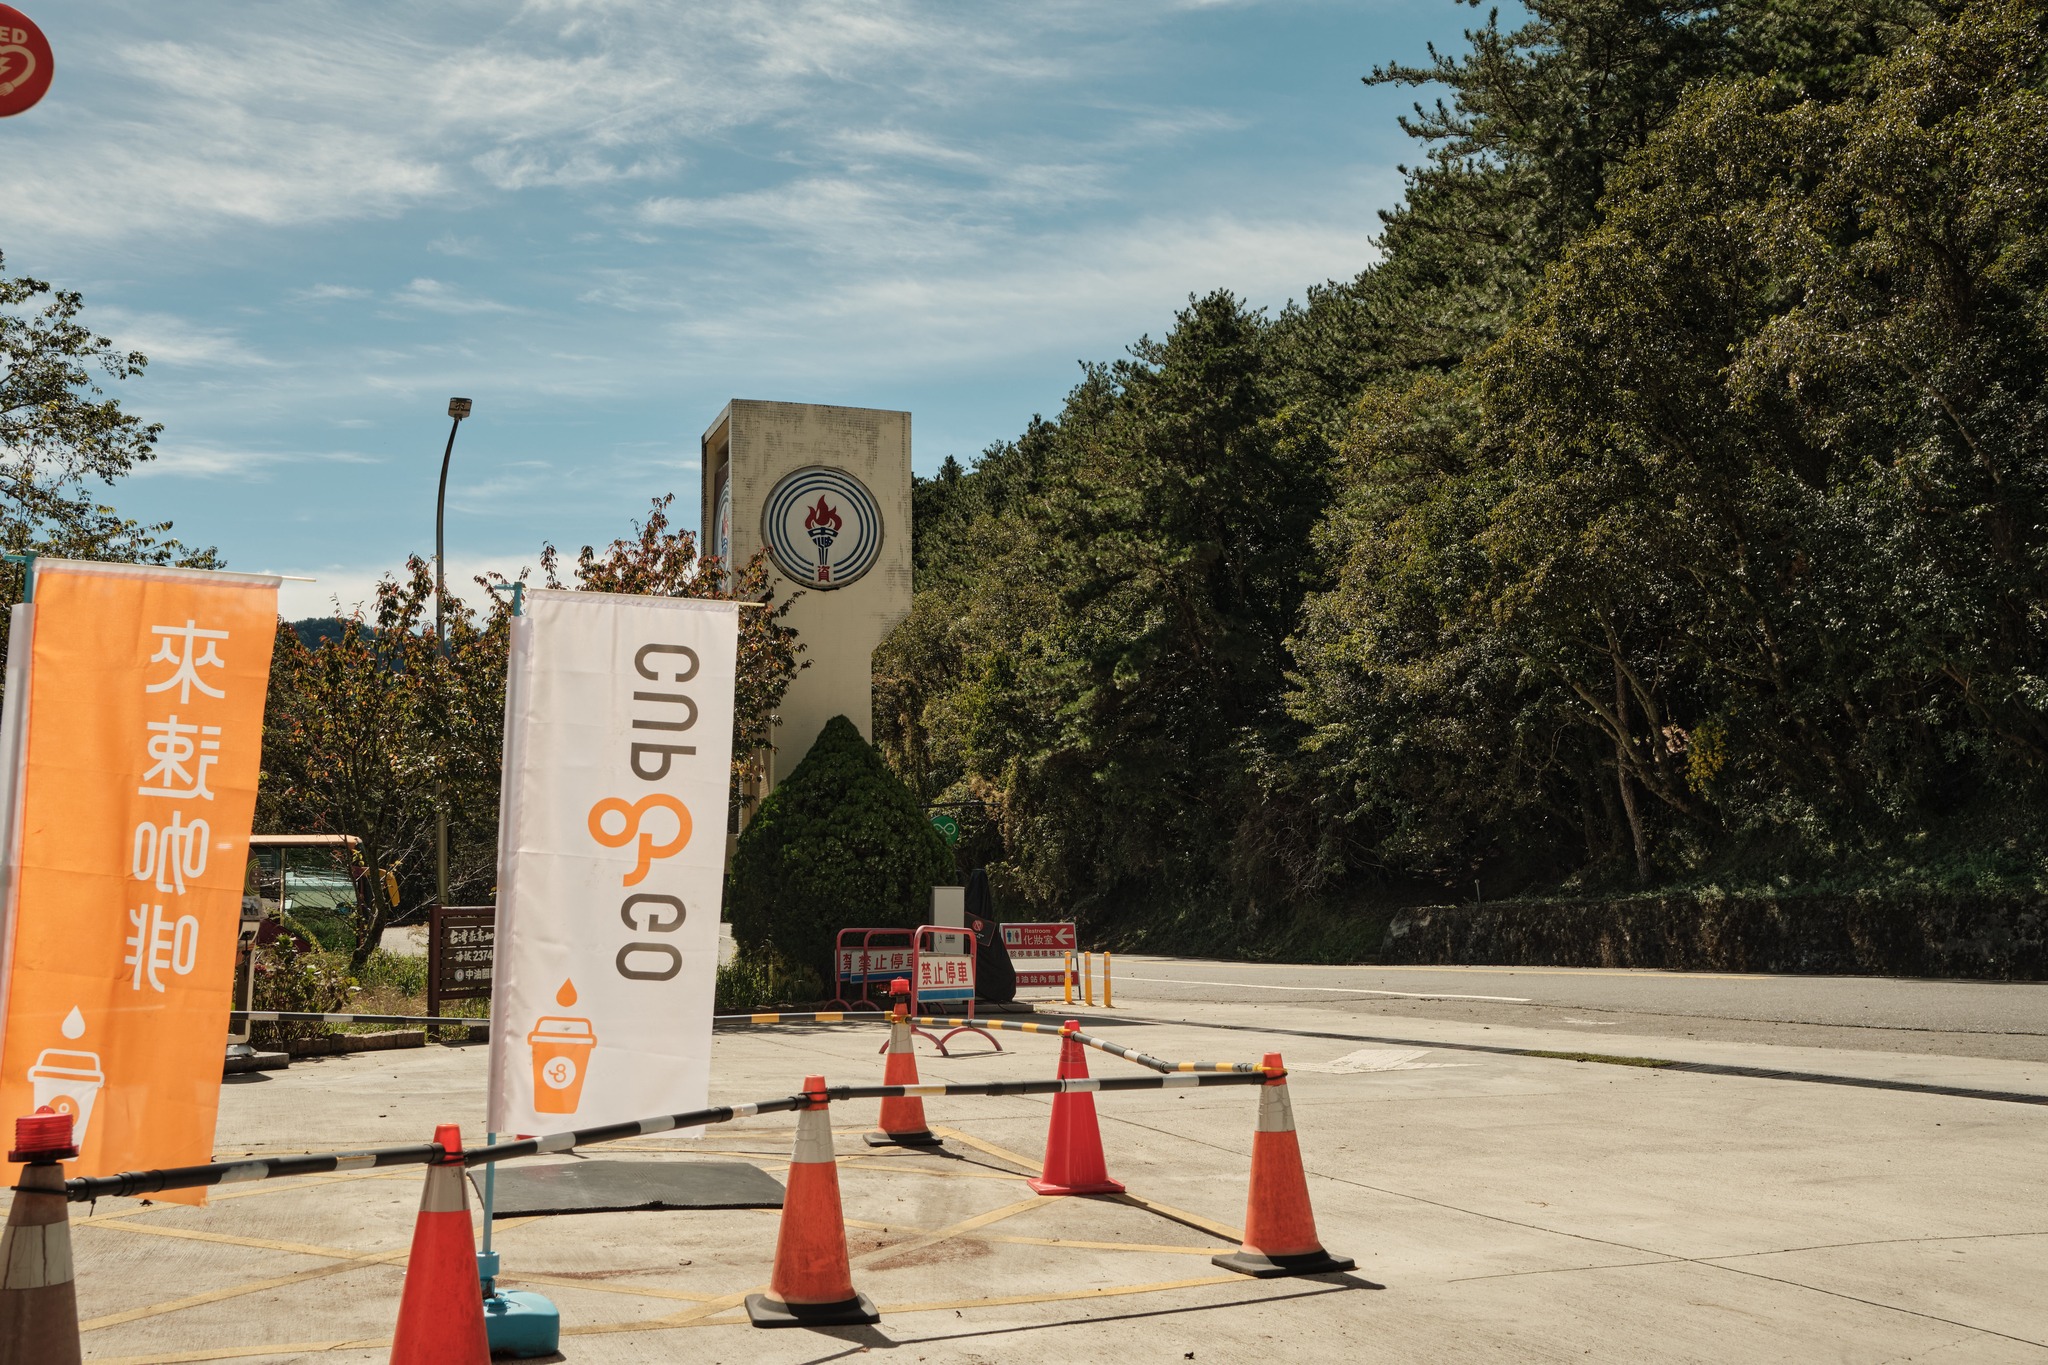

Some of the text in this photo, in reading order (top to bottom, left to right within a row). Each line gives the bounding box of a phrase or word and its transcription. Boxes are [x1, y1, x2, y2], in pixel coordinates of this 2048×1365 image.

[0, 25, 28, 44] ED
[921, 961, 968, 985] 禁止停車
